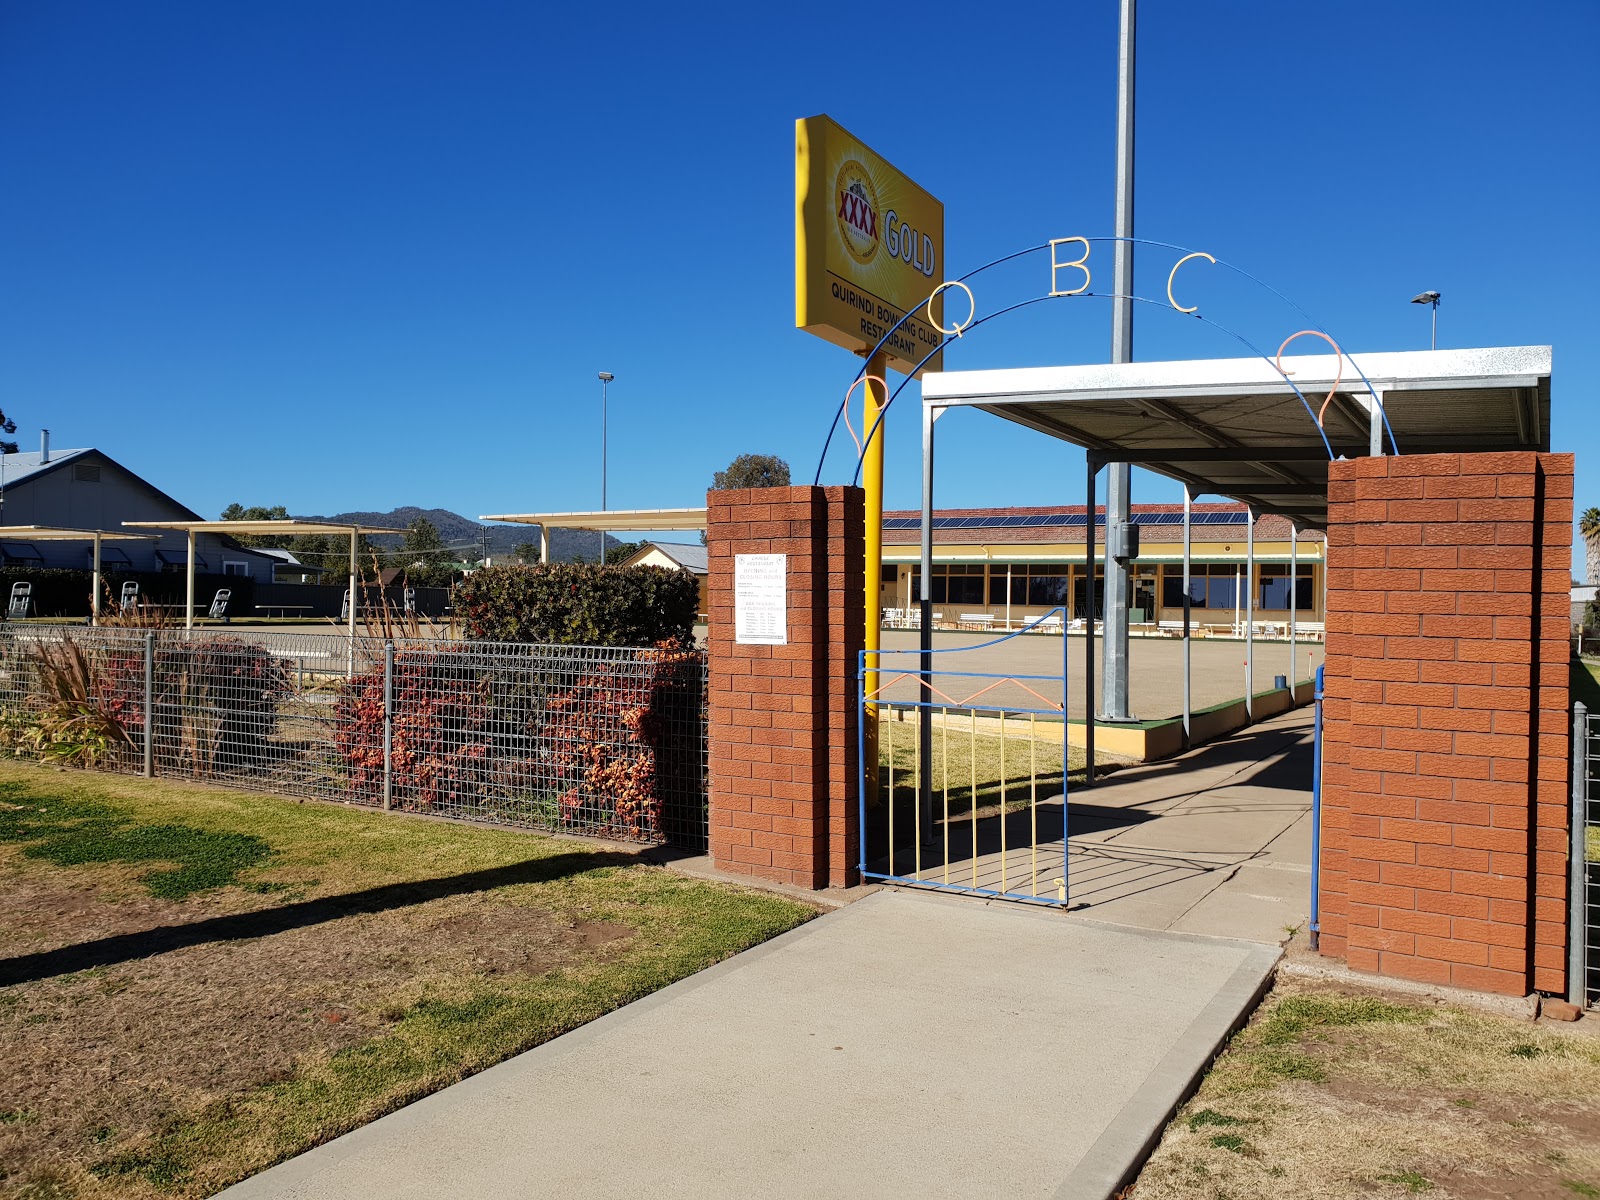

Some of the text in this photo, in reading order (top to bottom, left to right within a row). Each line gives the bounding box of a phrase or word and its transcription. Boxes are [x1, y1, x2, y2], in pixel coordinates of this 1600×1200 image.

[838, 190, 878, 241] XXXX
[885, 209, 935, 277] GOLD
[831, 282, 938, 347] QUIRINDI BOWLING CLUB
[927, 236, 1216, 338] Q B C
[860, 317, 916, 356] RESTAURANT
